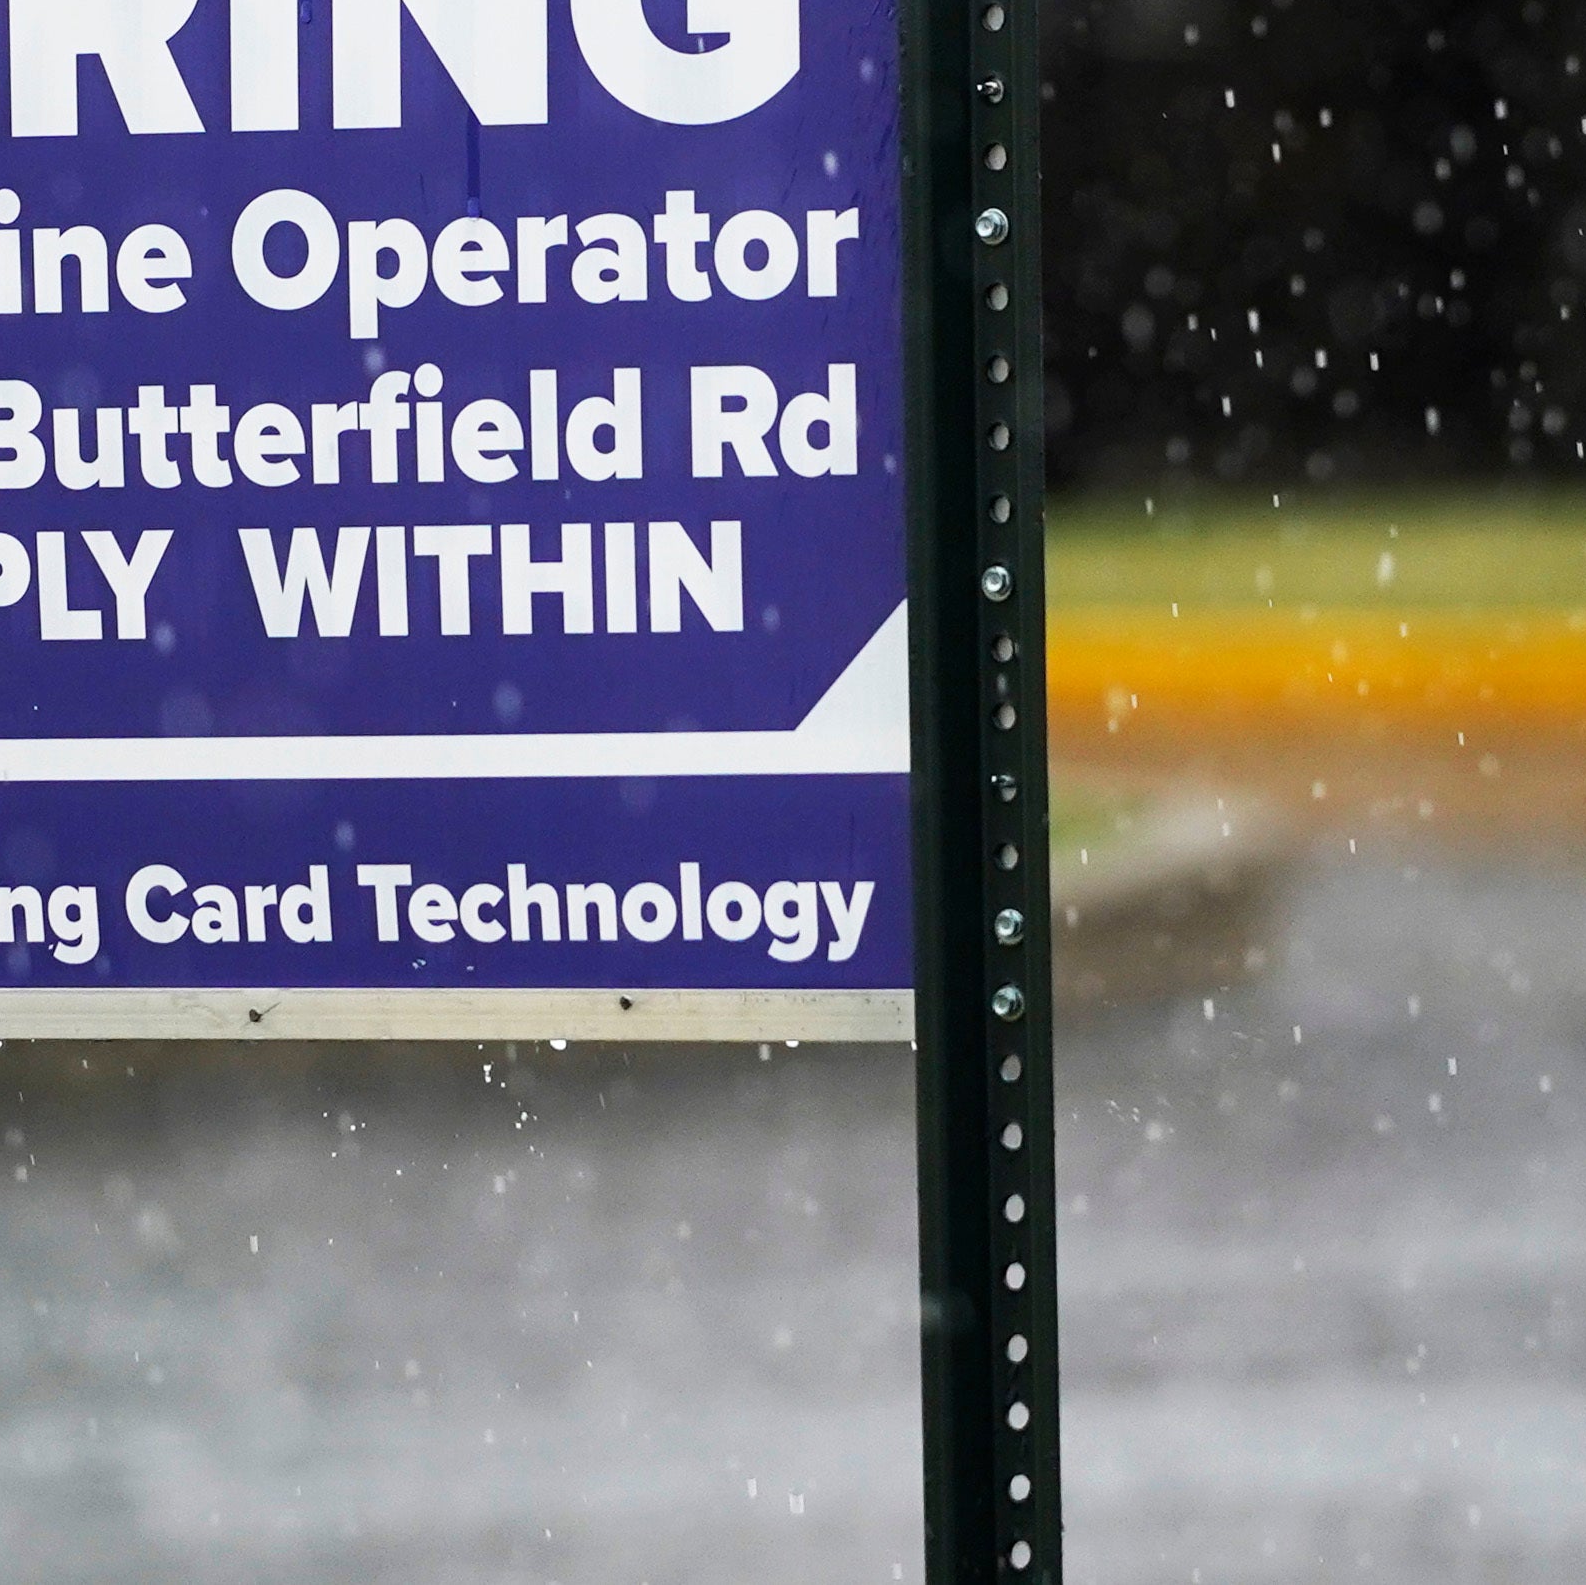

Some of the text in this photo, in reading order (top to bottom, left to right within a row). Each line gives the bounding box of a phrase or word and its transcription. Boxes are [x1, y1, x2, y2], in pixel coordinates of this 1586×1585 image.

[232, 188, 859, 339] Operator
[691, 364, 857, 477] Rd
[239, 521, 743, 637] WITHIN
[126, 864, 332, 943] Card
[357, 862, 874, 962] Technology
